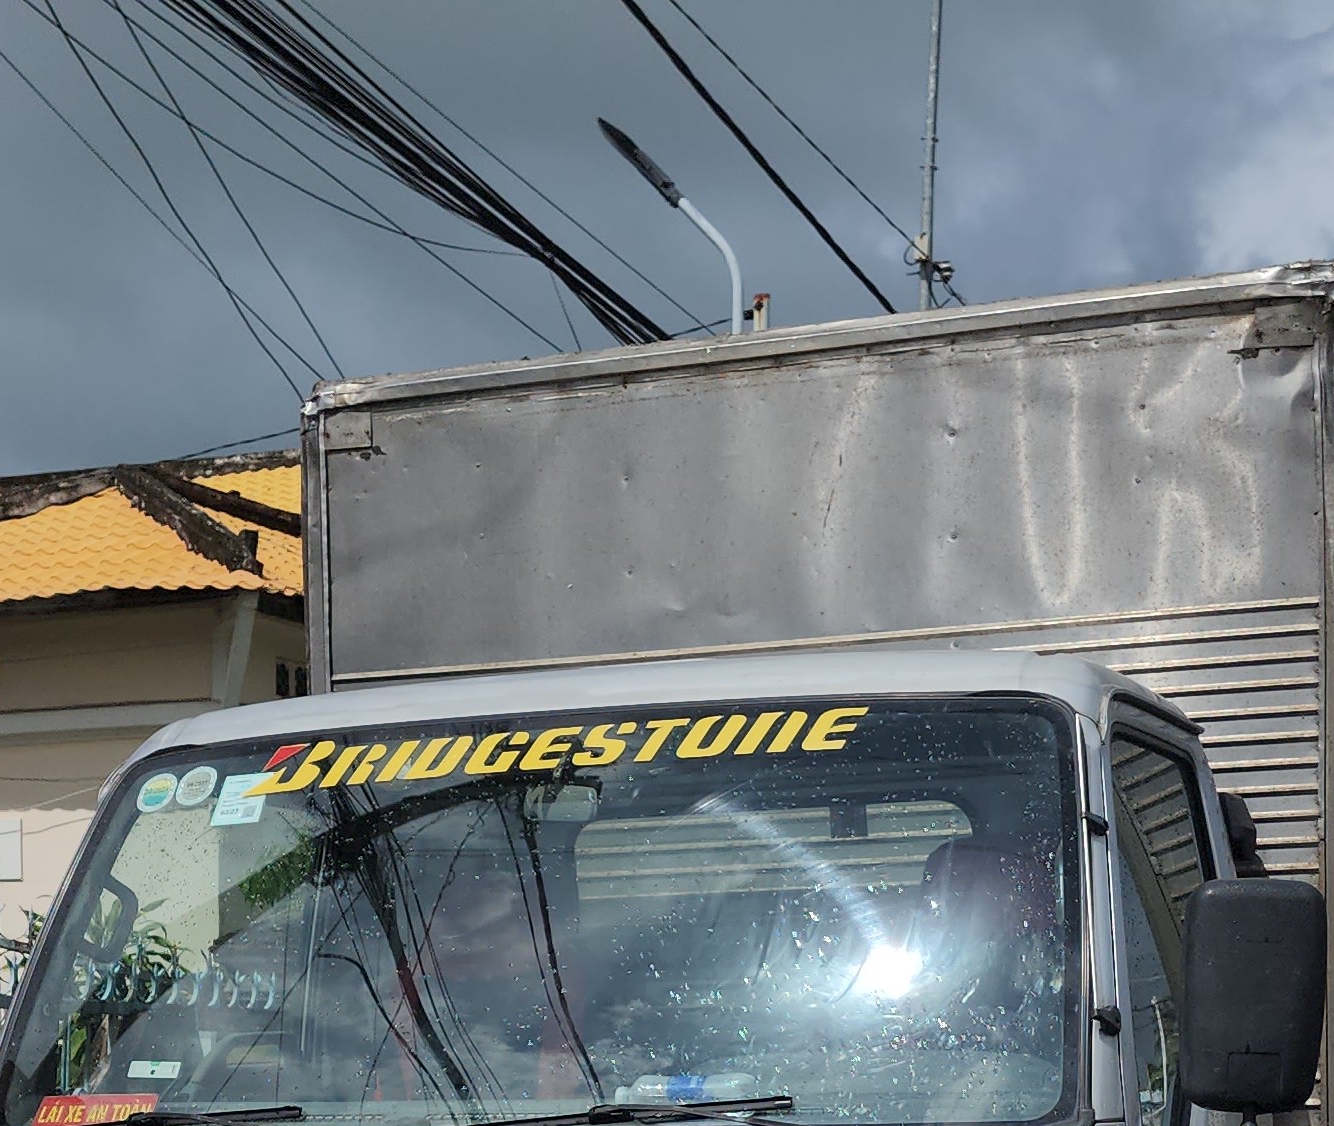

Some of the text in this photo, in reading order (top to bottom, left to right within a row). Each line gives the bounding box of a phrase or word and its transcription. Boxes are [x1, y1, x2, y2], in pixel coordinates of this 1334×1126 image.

[243, 707, 870, 798] BRIDGESTONE
[64, 1104, 86, 1123] XE
[86, 1104, 108, 1122] AN
